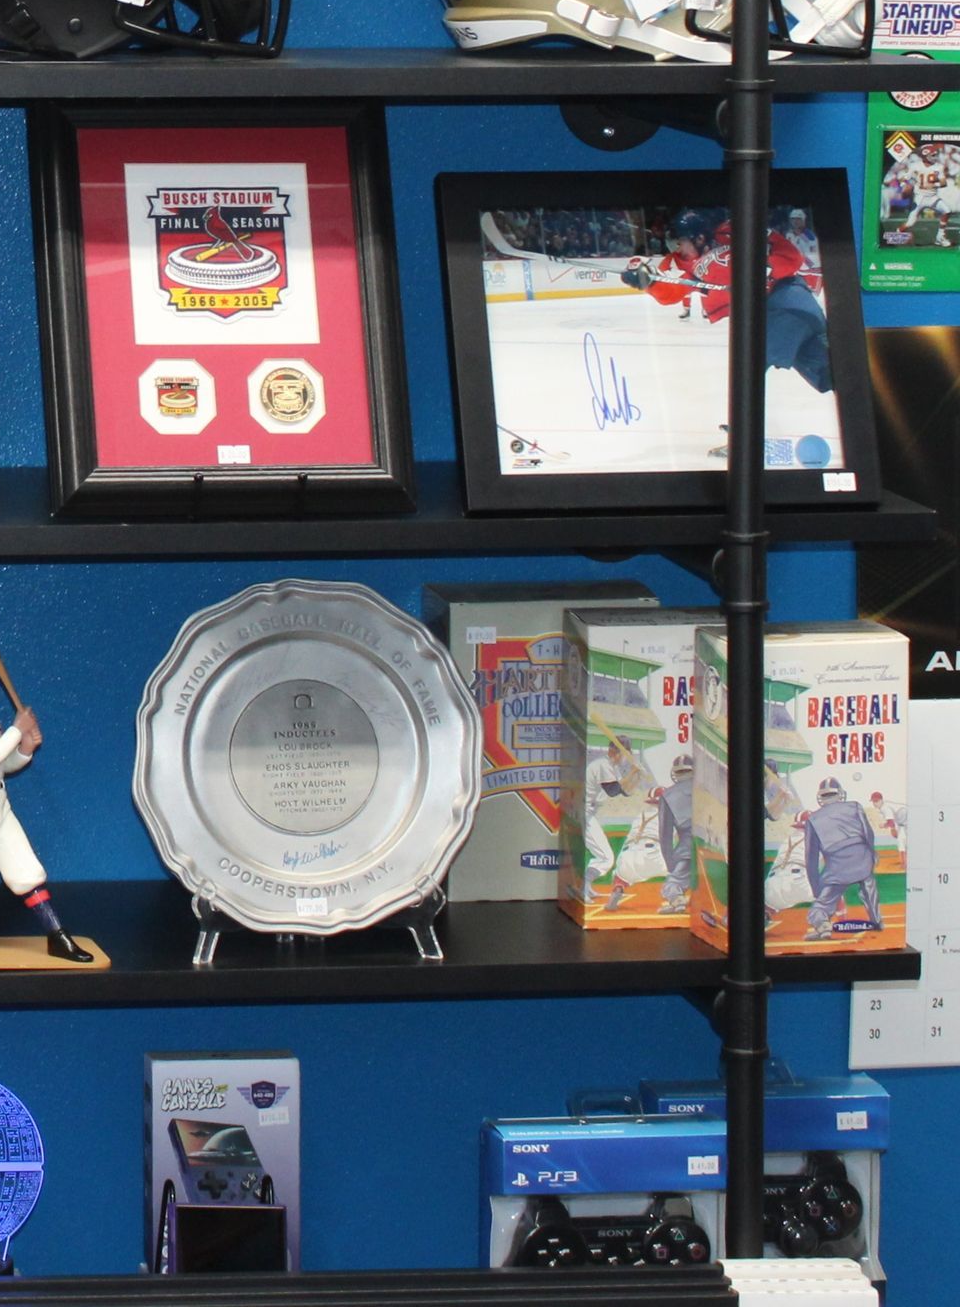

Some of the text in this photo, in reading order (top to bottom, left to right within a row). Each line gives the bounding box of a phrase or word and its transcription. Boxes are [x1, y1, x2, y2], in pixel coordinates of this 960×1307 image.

[892, 20, 954, 35] LINEUP
[163, 191, 273, 205] BUSCH STADIUM
[160, 216, 280, 229] FINAL SEASON
[181, 295, 269, 307] 1966 2005
[173, 639, 233, 717] NATIONAL
[390, 649, 413, 673] OF
[412, 676, 442, 729] FAME
[807, 693, 900, 728] BASEBALL
[278, 741, 333, 752] LOU BROCK
[826, 731, 885, 765] STARS
[265, 760, 350, 772] ENOS SLAUGHTER
[273, 779, 347, 791] ARKY VAUGHAN
[486, 770, 535, 789] LIMITED
[274, 796, 347, 809] HOYT WILHELM
[938, 810, 945, 822] 3
[937, 873, 949, 885] 10
[935, 935, 947, 946] 17
[870, 998, 944, 1010] 23 24
[869, 1026, 942, 1040] 30 31
[161, 1076, 214, 1094] GAMES
[160, 1092, 227, 1112] CONSOLE
[668, 1104, 705, 1113] SONY
[512, 1144, 550, 1153] SONY
[537, 1170, 578, 1183] PS3
[597, 1229, 633, 1238] SONY
